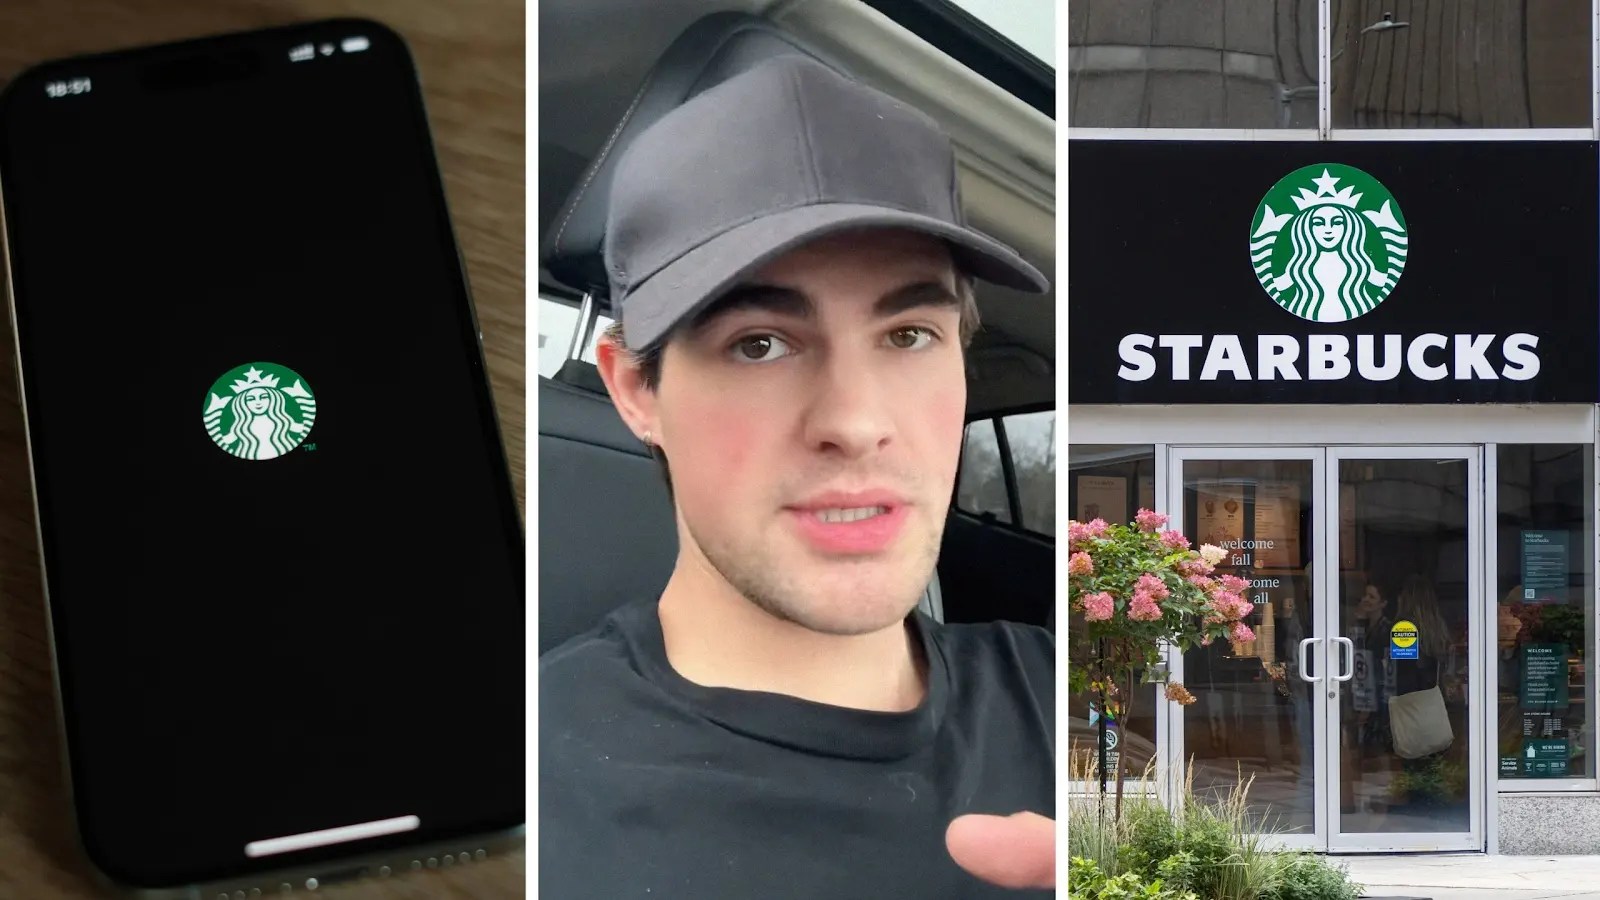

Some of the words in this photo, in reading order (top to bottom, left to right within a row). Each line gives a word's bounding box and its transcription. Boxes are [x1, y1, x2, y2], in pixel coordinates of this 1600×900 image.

[1117, 332, 1541, 382] STARBUCKS
[1220, 537, 1274, 549] welcome
[1231, 553, 1251, 566] fall
[1243, 577, 1280, 588] come
[1253, 591, 1269, 604] all
